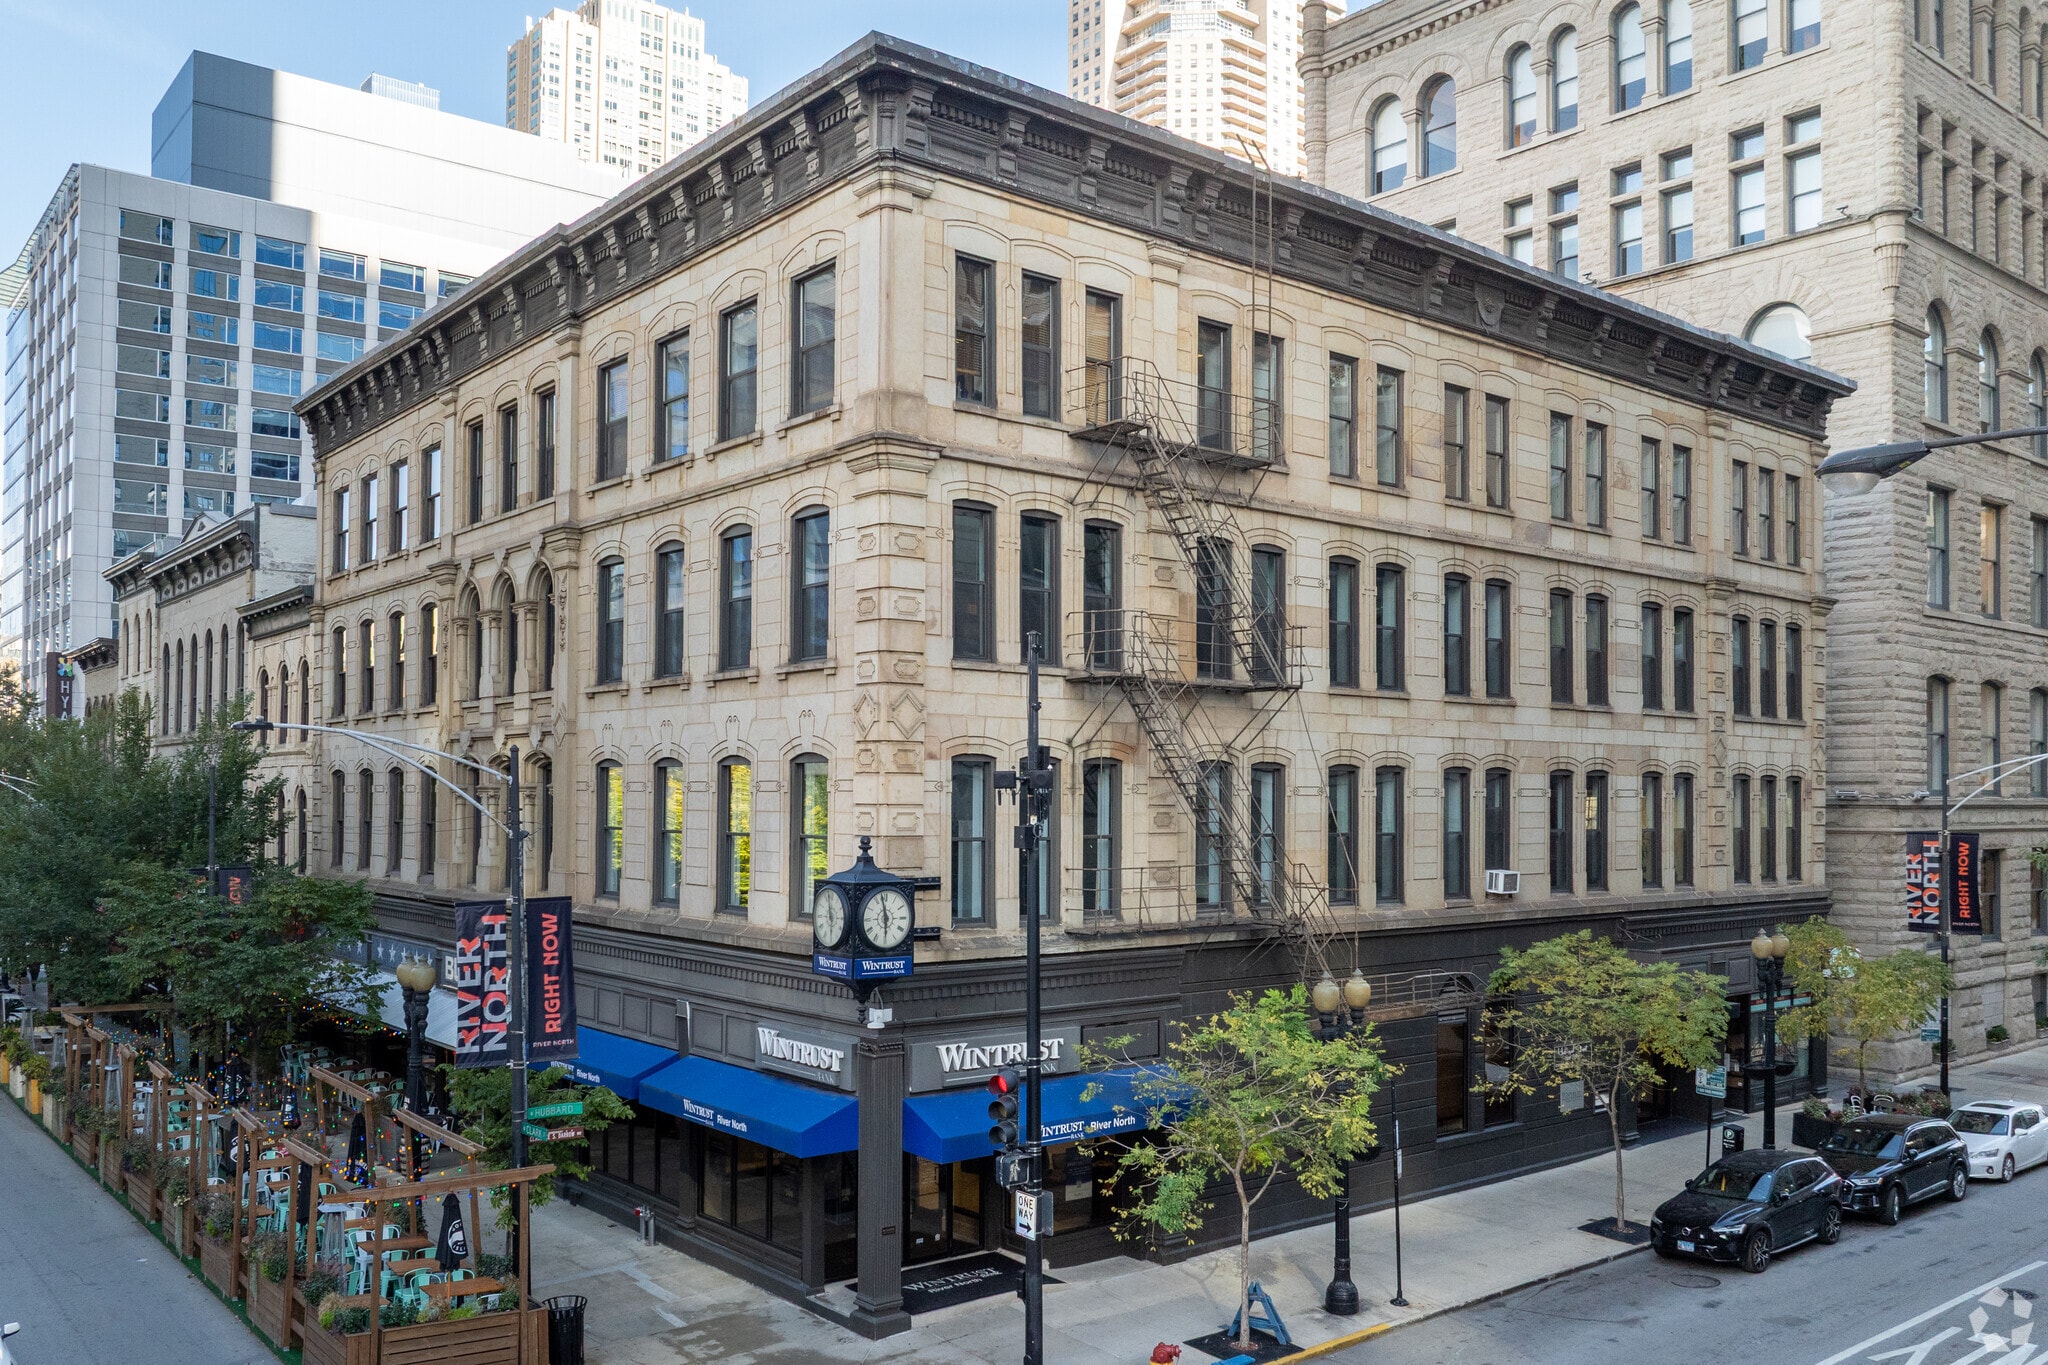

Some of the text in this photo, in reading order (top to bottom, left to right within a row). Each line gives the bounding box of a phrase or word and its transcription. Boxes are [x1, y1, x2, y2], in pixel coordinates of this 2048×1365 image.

[1906, 853, 1922, 924] RIVER
[1922, 840, 1940, 925] NORTH
[1957, 842, 1971, 919] RIGHT NOW
[818, 956, 847, 970] WINTRUST
[862, 960, 905, 970] WINTRUST
[541, 913, 562, 1034] RIGHT NOW
[481, 914, 507, 1052] NORTH
[455, 936, 482, 1054] RIVER
[533, 1038, 575, 1048] RIVER NORTH
[757, 1026, 845, 1072] WINTRUST
[587, 1072, 601, 1084] North
[534, 1105, 574, 1117] HUBBARD
[683, 1098, 747, 1132] WINTRUST River North
[1090, 1120, 1112, 1131] River
[1113, 1115, 1136, 1128] North
[526, 1125, 542, 1138] CLARK
[1018, 1195, 1034, 1210] ONE
[1017, 1207, 1034, 1221] WAY
[902, 1267, 996, 1292] WINTRUST
[928, 1284, 954, 1294] River
[956, 1278, 983, 1287] North
